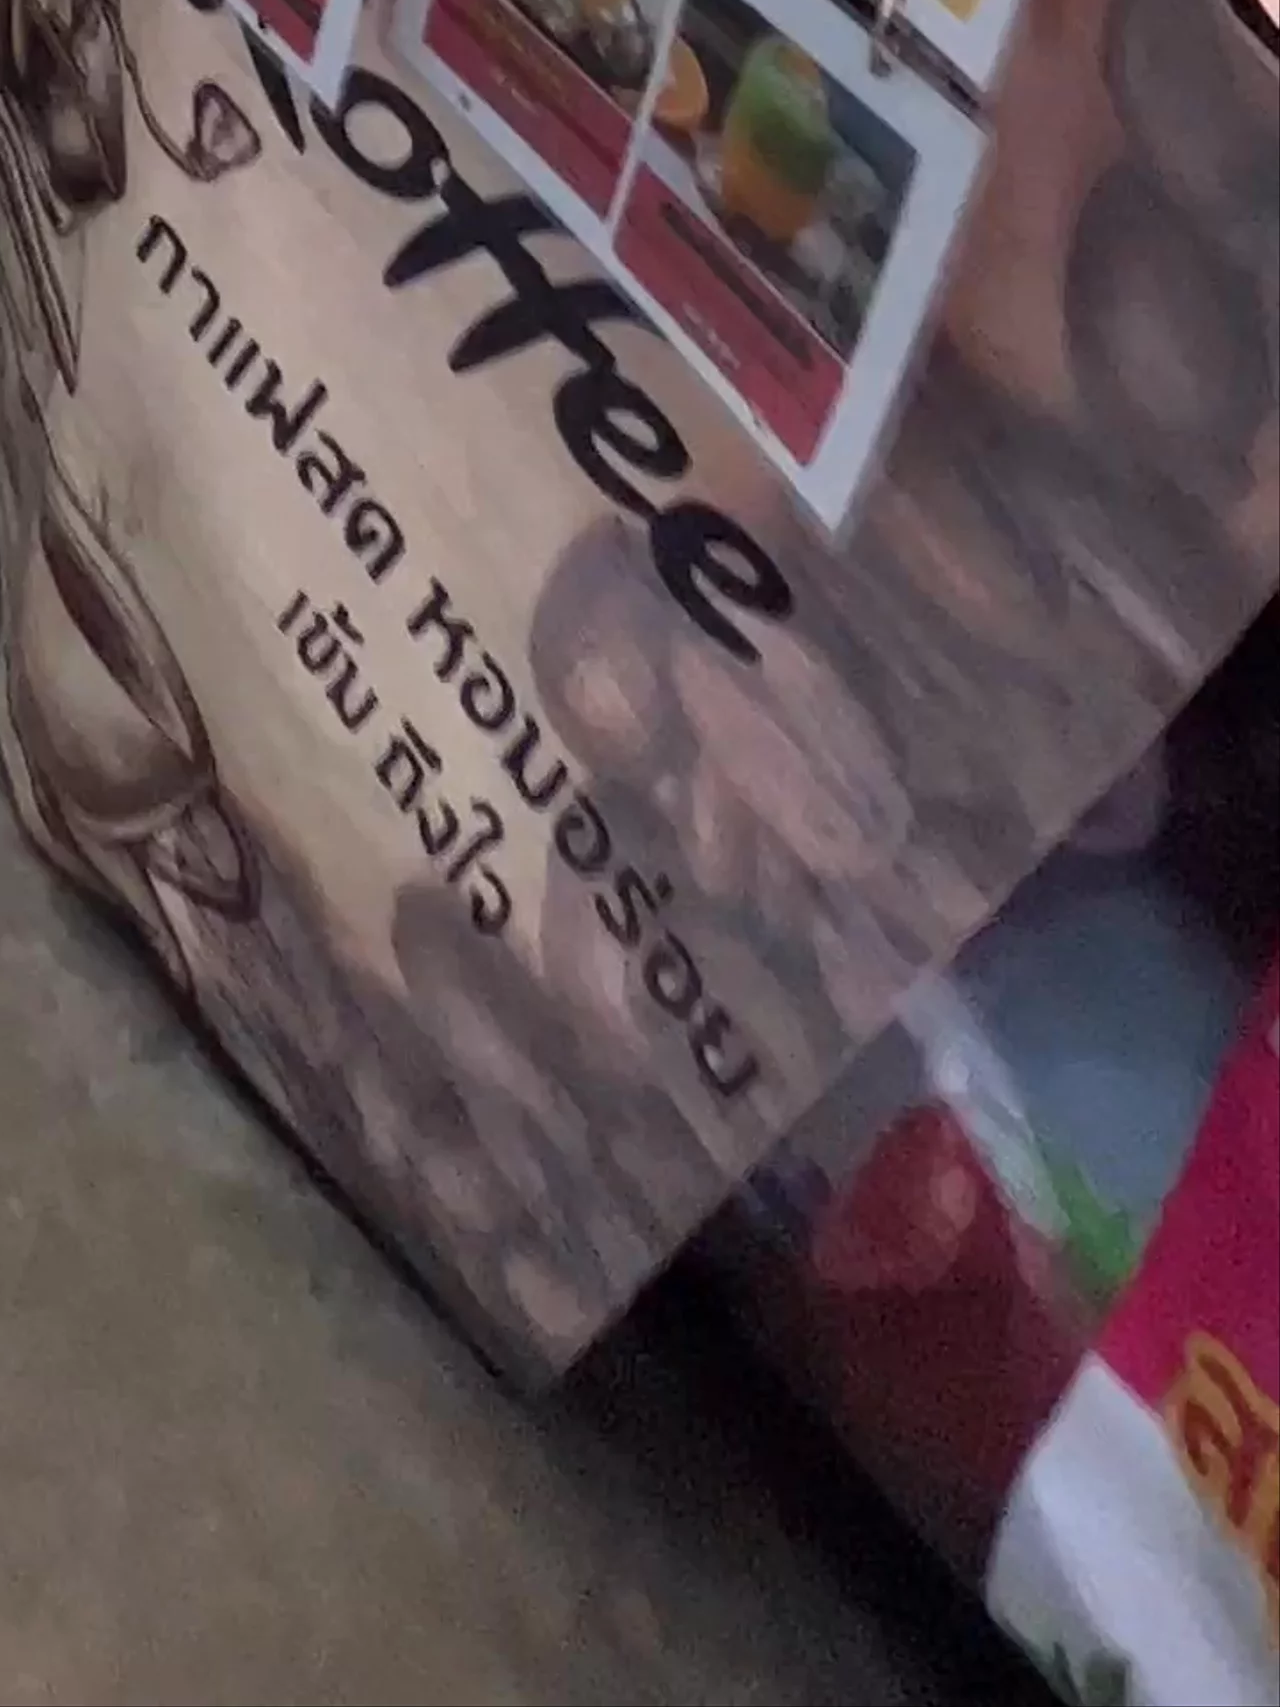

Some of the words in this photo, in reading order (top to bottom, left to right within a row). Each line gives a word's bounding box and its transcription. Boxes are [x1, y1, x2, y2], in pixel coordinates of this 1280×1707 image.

[135, 214, 406, 584] กาแฟสด
[406, 576, 760, 1100] หอมอร่อย
[242, 15, 793, 665] offee
